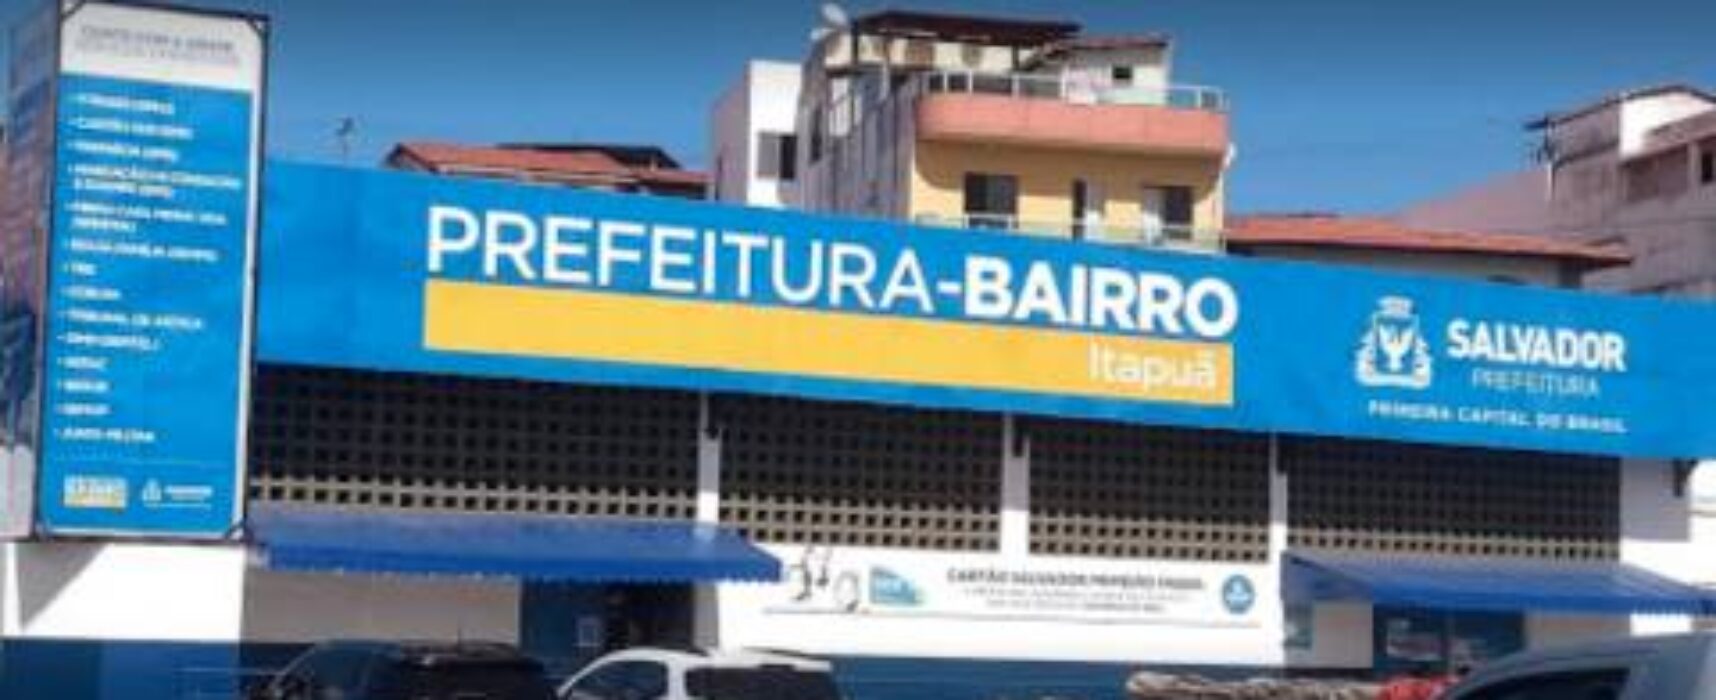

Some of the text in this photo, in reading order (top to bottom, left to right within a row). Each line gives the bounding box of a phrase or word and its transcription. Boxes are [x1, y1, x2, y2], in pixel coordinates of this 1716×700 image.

[1446, 318, 1627, 373] SALVADOR
[1088, 341, 1217, 392] Itapuã
[1472, 367, 1600, 398] PREFEITURA
[1457, 405, 1531, 427] CAPITAL
